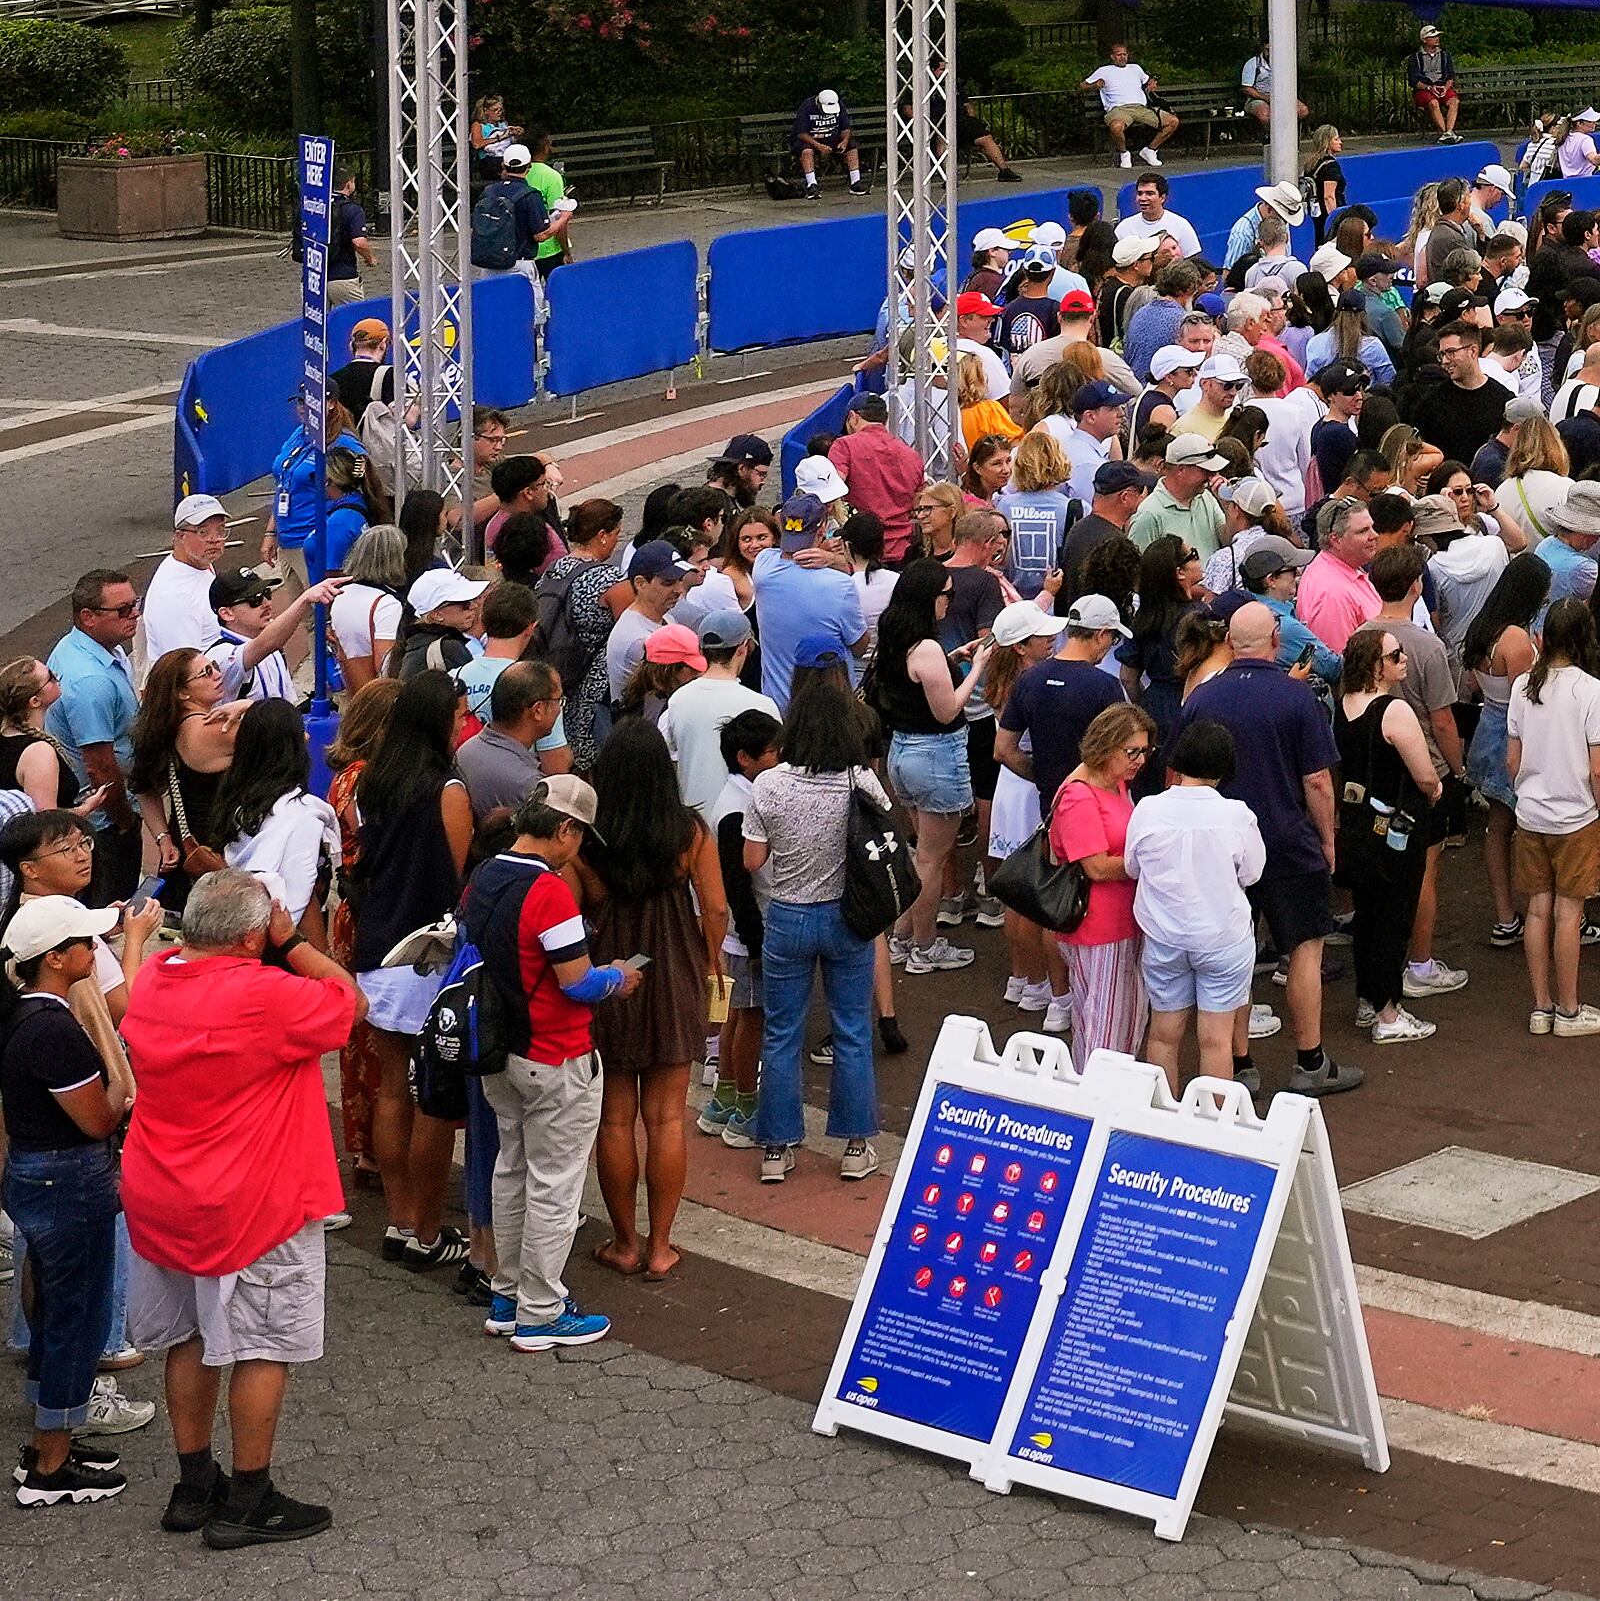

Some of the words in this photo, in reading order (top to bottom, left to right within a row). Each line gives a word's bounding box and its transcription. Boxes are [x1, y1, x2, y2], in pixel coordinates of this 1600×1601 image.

[304, 140, 326, 164] ENTER
[306, 164, 324, 187] HERE
[303, 195, 327, 219] Hospitality
[784, 516, 804, 532] M
[1011, 506, 1056, 520] Wilson
[938, 1100, 996, 1134] Security
[996, 1113, 1074, 1151] Procedures
[1108, 1163, 1169, 1198] Security
[1169, 1176, 1252, 1214] Procedures
[845, 1391, 859, 1401] us
[856, 1393, 879, 1407] open
[1017, 1446, 1032, 1458] us
[1030, 1449, 1054, 1463] open
